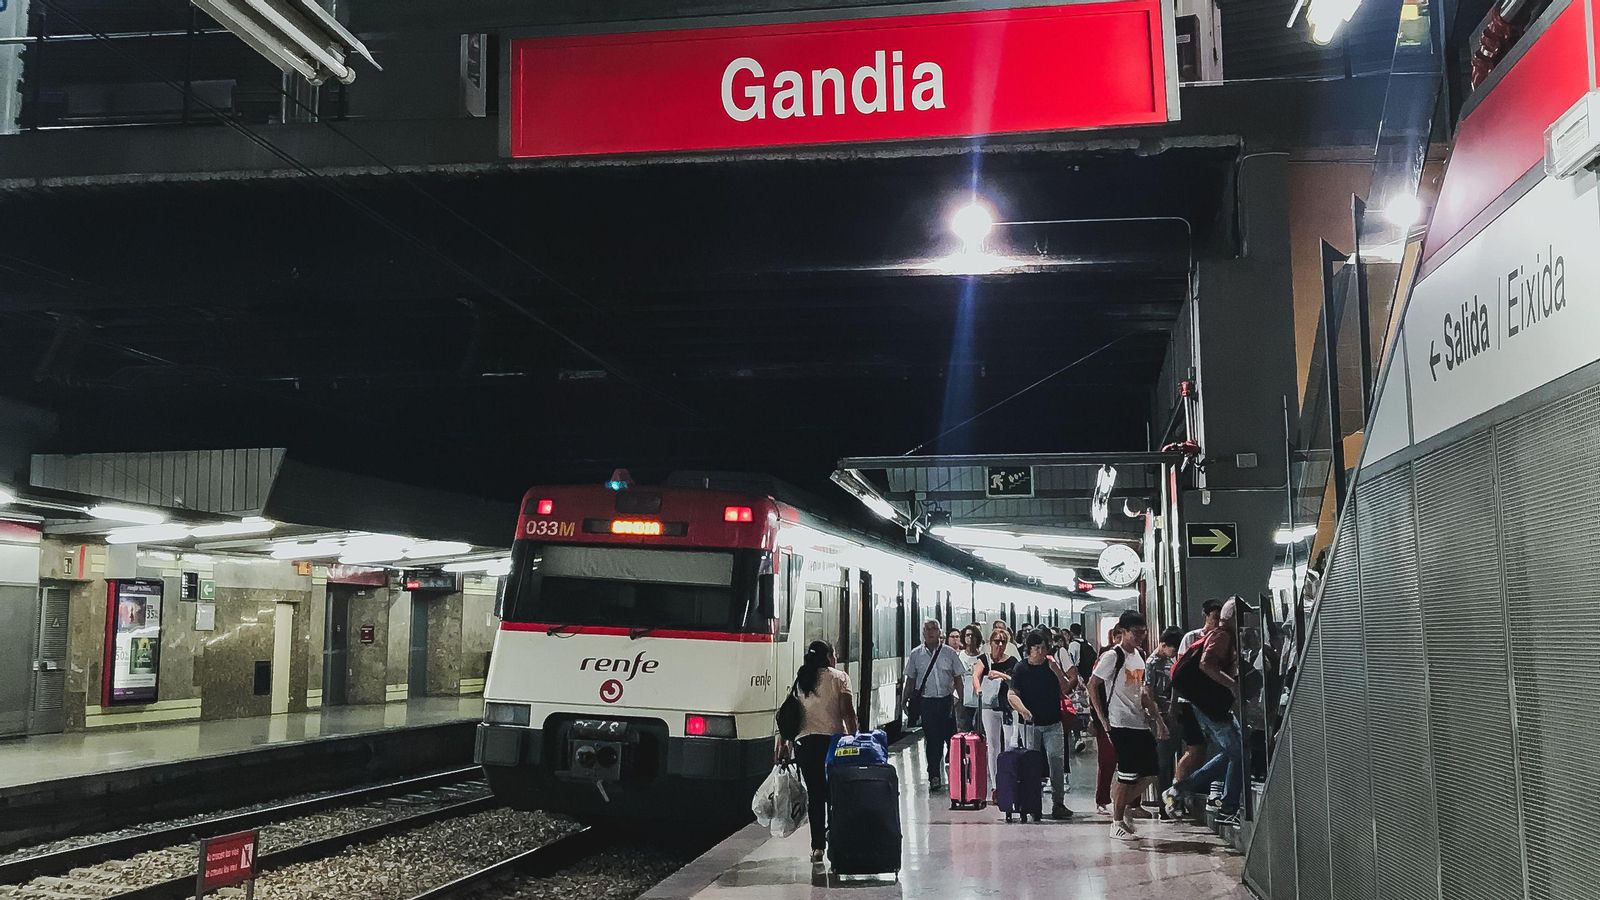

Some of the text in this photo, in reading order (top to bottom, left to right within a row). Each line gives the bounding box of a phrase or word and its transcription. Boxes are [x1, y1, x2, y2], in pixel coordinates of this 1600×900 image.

[721, 50, 946, 122] Gandia
[1444, 244, 1566, 371] Salida Eixida
[526, 520, 576, 537] 033M
[580, 651, 659, 682] renfe
[750, 669, 772, 692] renfe
